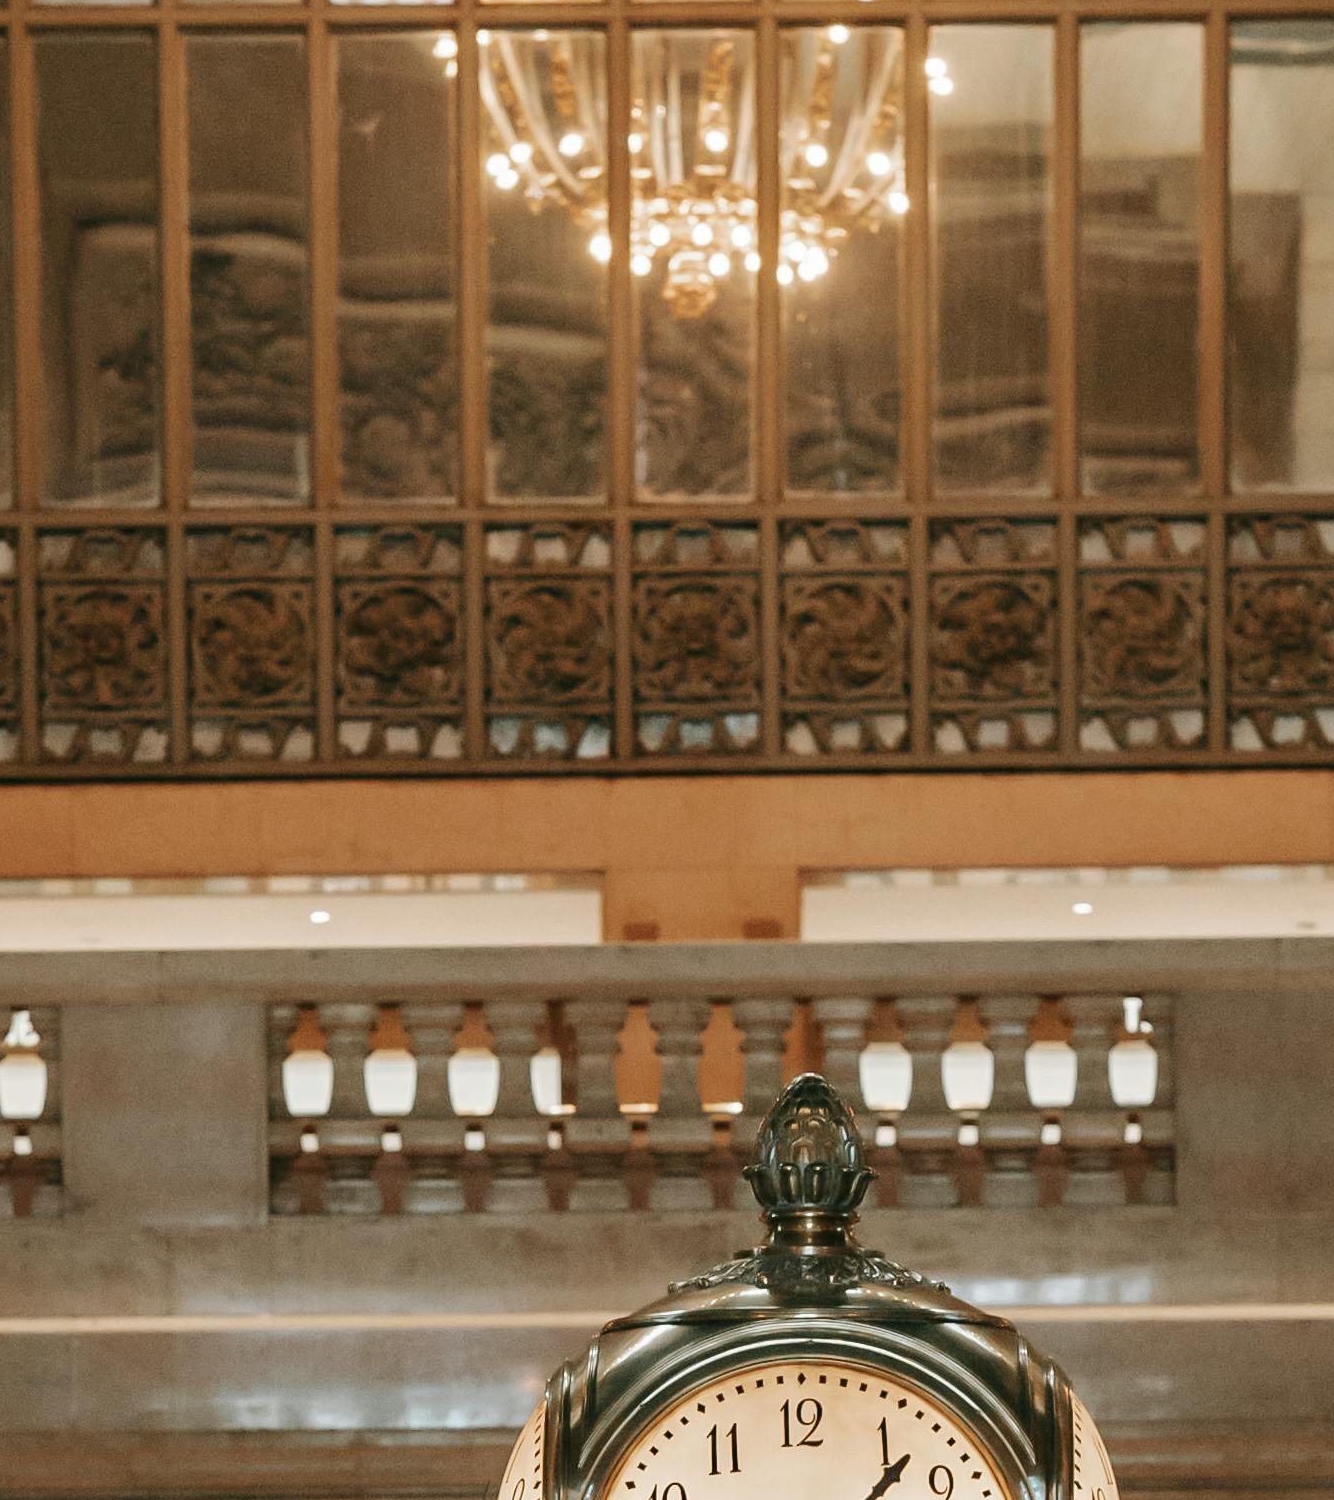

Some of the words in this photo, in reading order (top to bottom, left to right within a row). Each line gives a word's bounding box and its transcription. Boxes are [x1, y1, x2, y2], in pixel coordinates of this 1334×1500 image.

[779, 1398, 824, 1448] 12
[877, 1416, 893, 1466] 1
[706, 1422, 741, 1476] 11
